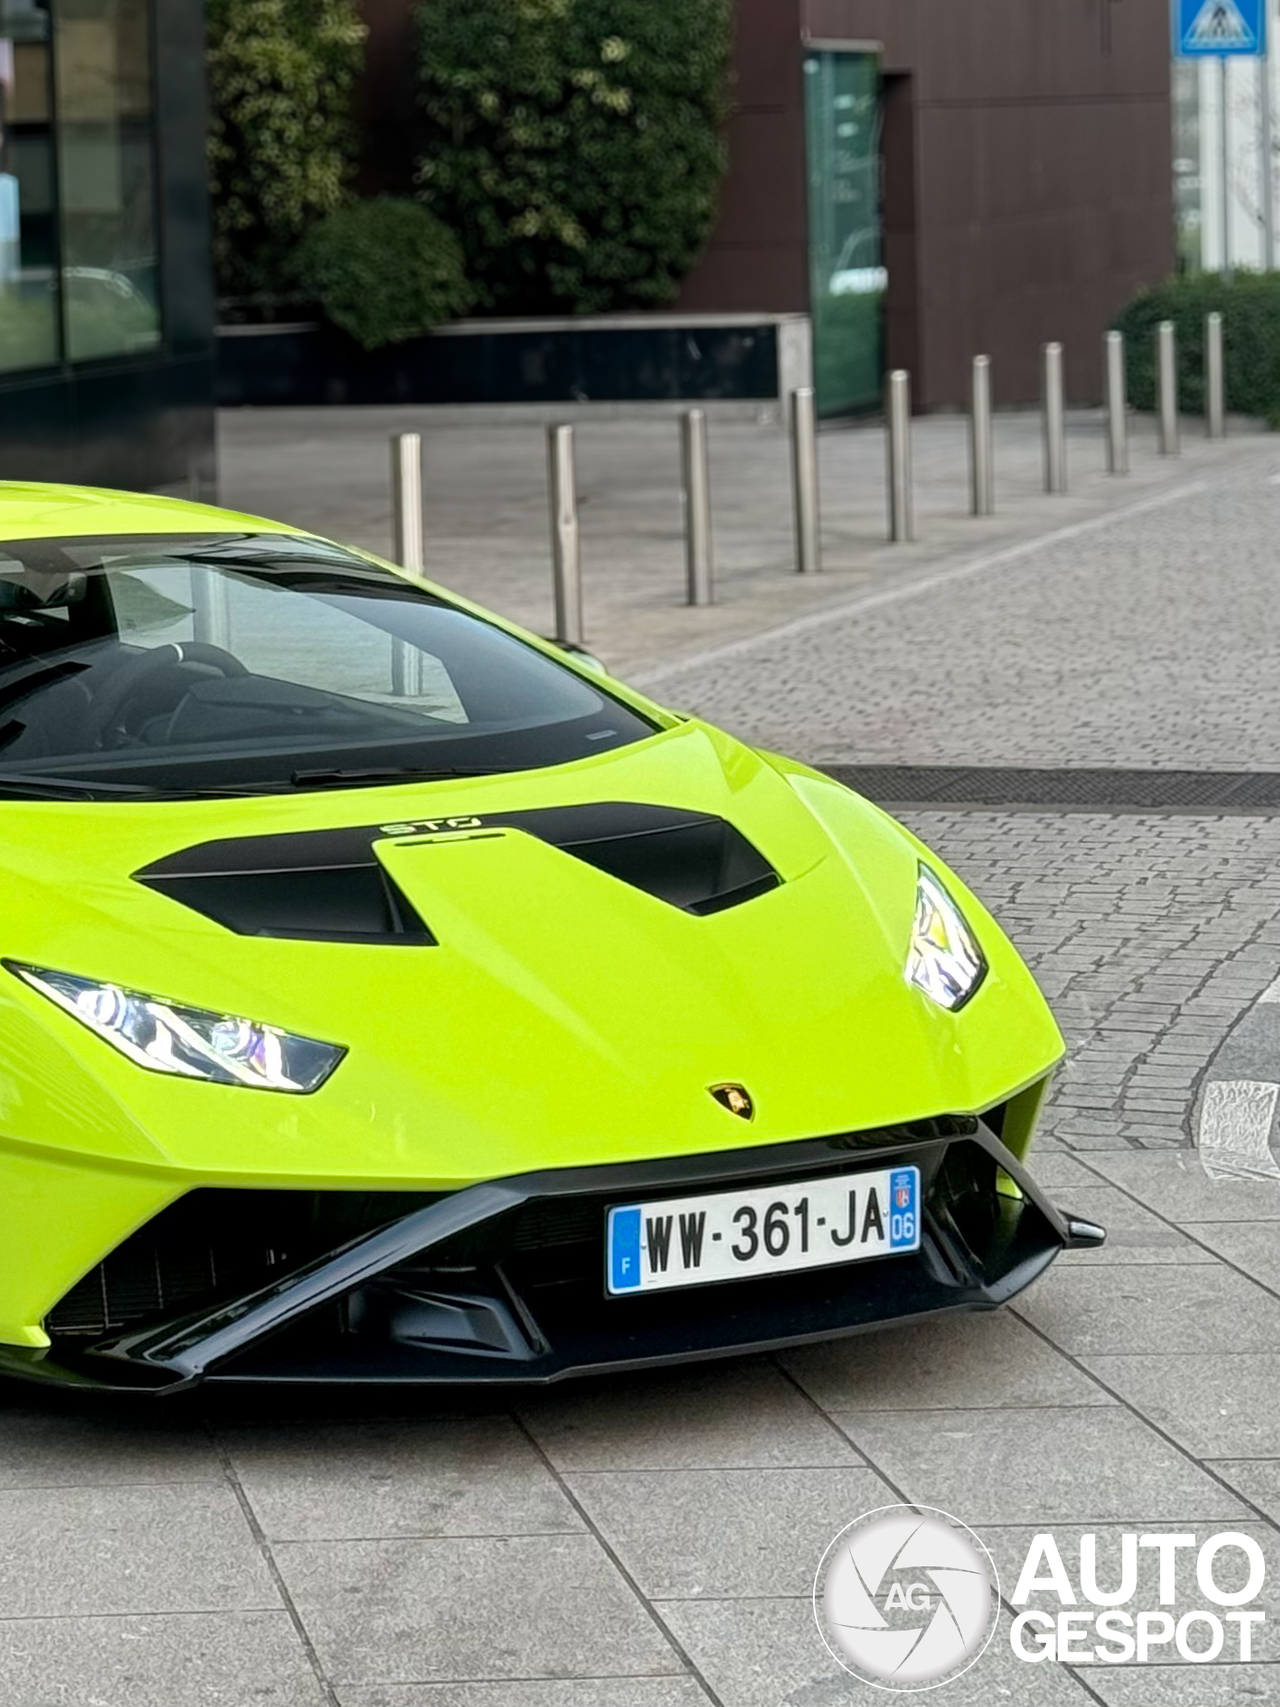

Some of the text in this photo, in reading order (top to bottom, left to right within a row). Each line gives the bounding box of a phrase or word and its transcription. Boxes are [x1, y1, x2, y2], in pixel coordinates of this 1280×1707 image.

[379, 817, 481, 835] STO
[646, 1187, 885, 1273] WW-361-JA
[892, 1212, 915, 1240] 06
[622, 1257, 631, 1275] F
